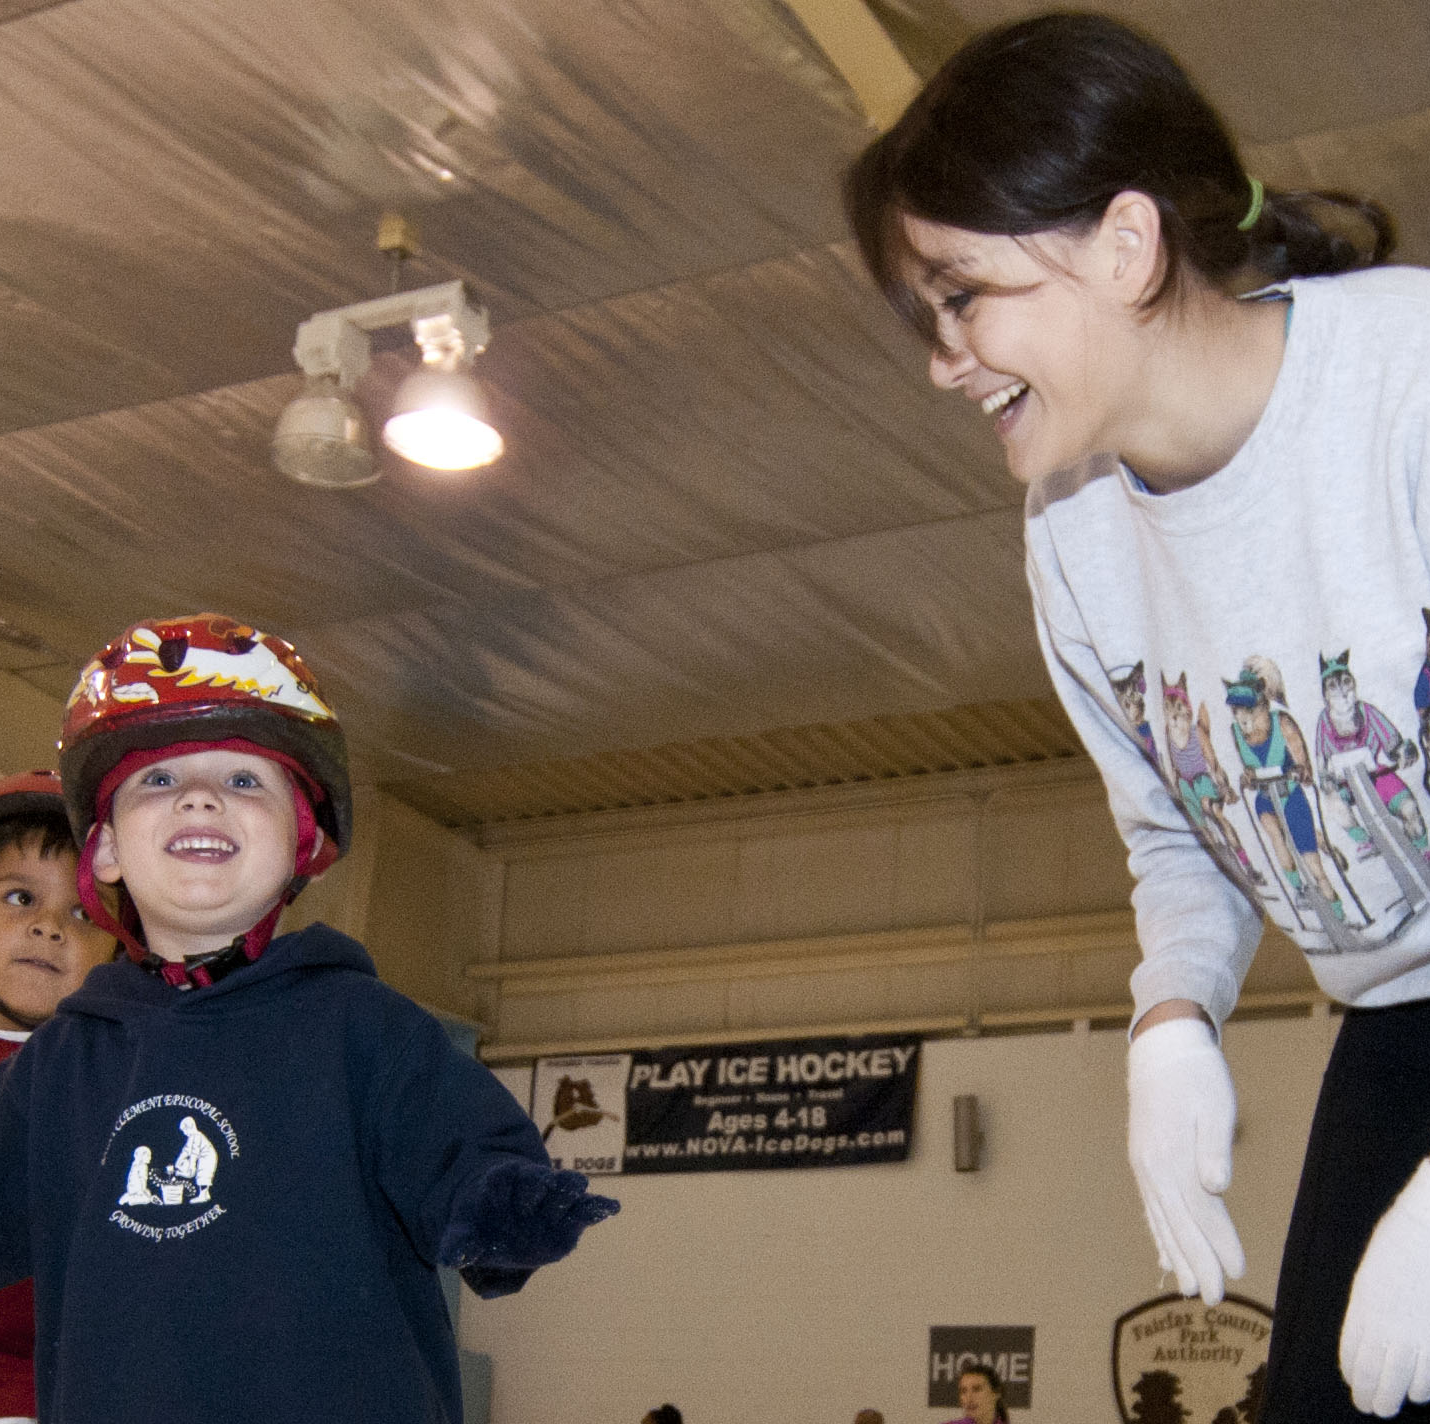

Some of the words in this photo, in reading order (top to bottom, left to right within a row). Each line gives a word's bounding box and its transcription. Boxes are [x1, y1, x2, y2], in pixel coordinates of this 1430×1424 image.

[630, 1058, 712, 1089] PLAY
[718, 1055, 769, 1085] ICE
[775, 1046, 915, 1084] HOCKEY
[114, 1093, 163, 1132] CLEMENT
[163, 1093, 222, 1122] EPISCOPAL
[216, 1118, 240, 1160] SCHOOL
[708, 1111, 768, 1135] Ages
[774, 1106, 827, 1128] 4-18
[108, 1209, 164, 1243] GROWING
[164, 1203, 228, 1240] TOGETHER
[1131, 1312, 1193, 1342] Fairfax
[1204, 1308, 1271, 1343] County
[1179, 1324, 1220, 1343] Park
[1153, 1344, 1245, 1367] Authority
